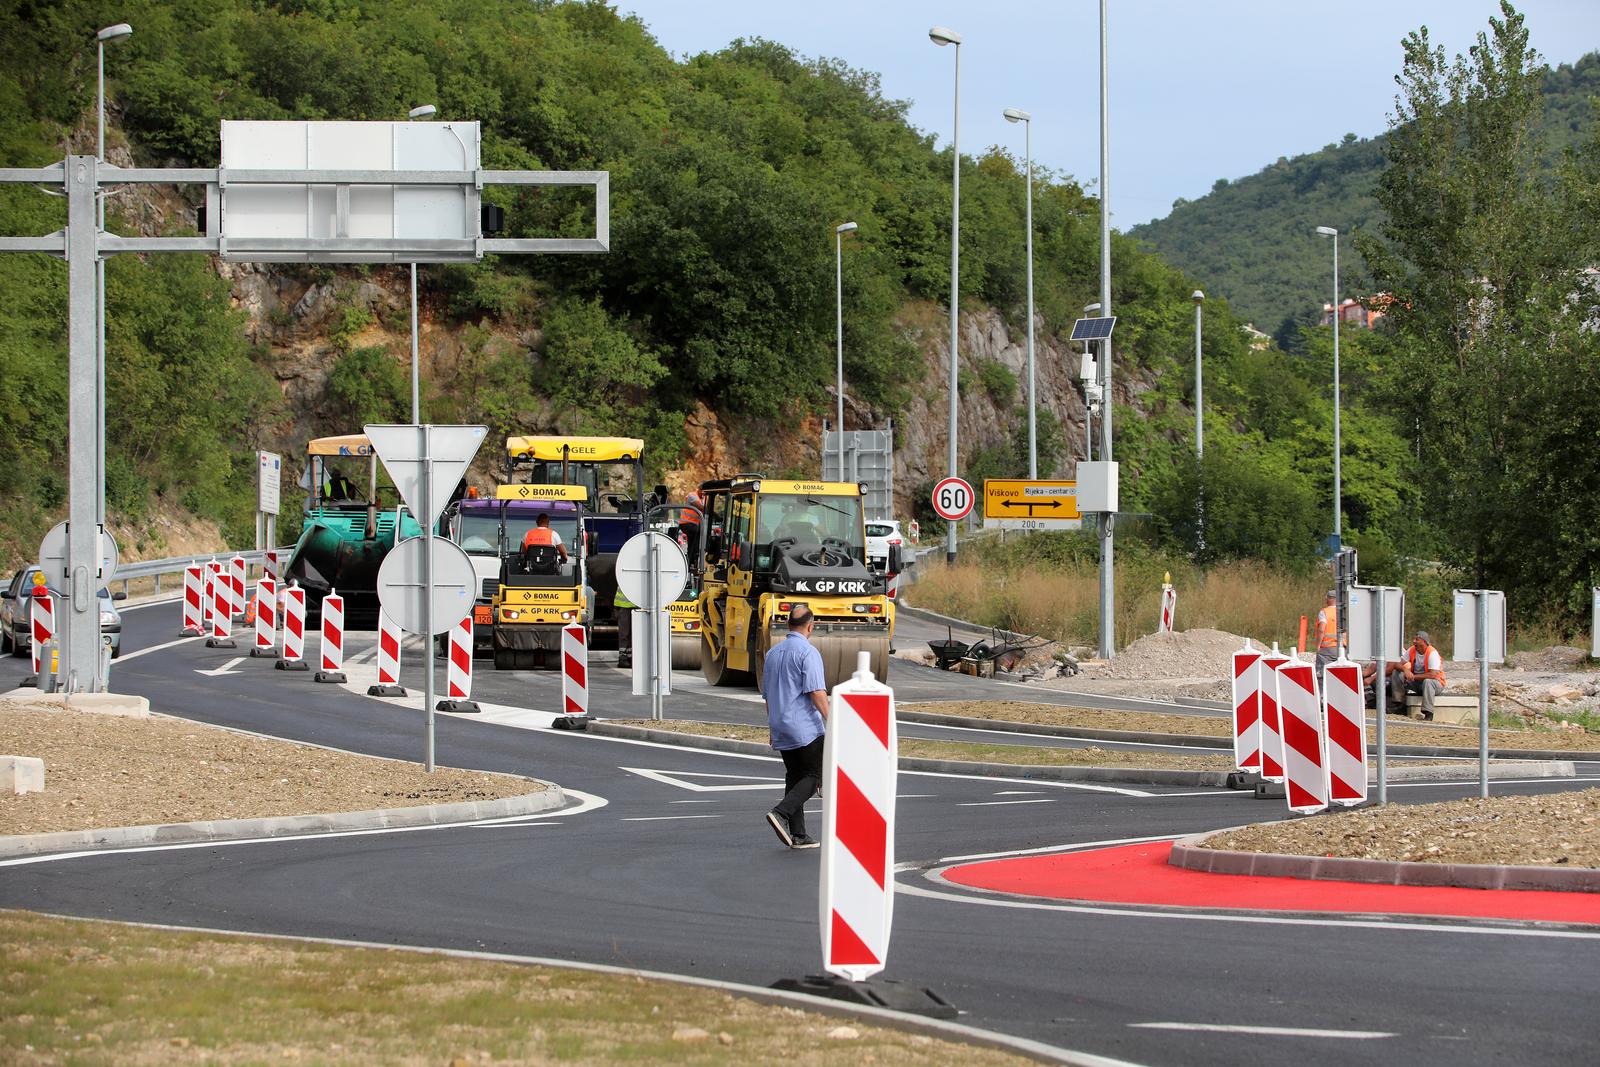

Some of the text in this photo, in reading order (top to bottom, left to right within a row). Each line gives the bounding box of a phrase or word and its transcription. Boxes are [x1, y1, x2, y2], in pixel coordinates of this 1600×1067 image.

[532, 488, 566, 496] BOMAG
[989, 488, 1019, 497] Viškovo
[1025, 487, 1043, 496] Rijeka
[941, 488, 965, 509] 60
[1022, 520, 1036, 529] 200
[815, 581, 835, 592] GP
[838, 581, 866, 593] KRK
